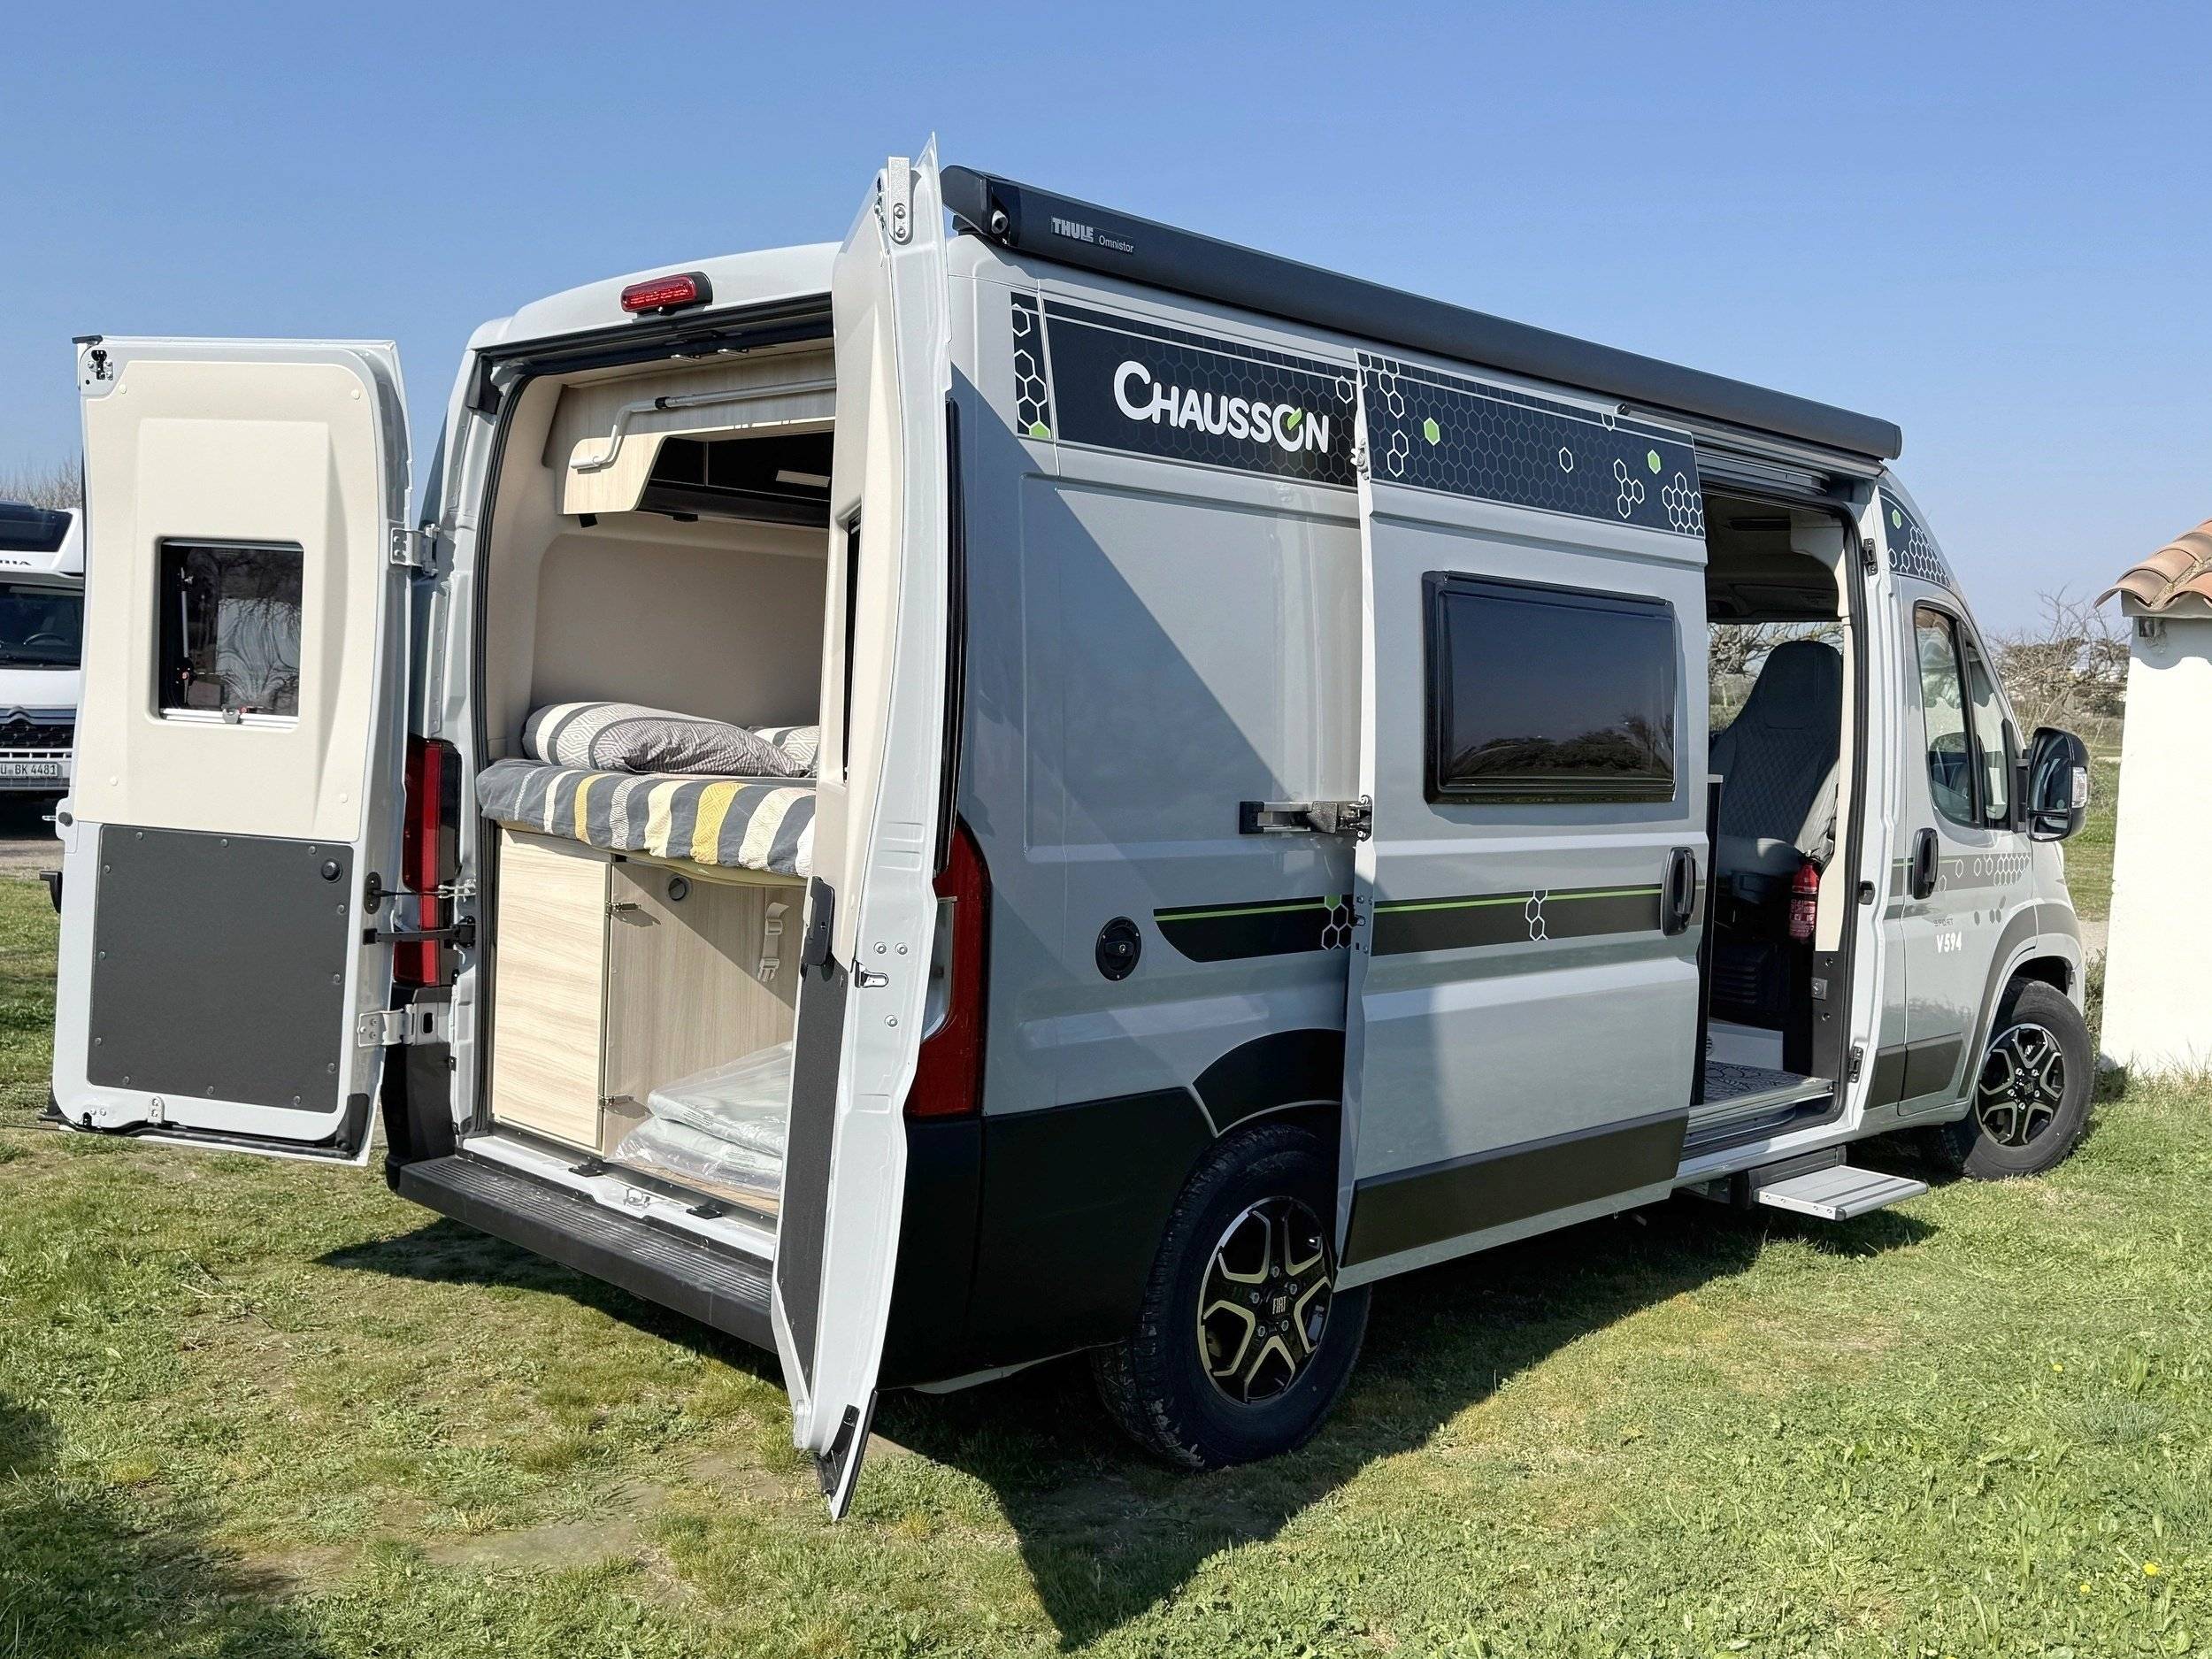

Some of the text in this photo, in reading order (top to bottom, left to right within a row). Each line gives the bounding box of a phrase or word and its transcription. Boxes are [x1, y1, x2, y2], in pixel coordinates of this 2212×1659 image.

[1052, 217, 1134, 253] THULE Omnistor
[1113, 360, 1329, 454] CHAUSSON
[15, 764, 27, 775] BK
[31, 764, 57, 775] 4481
[1936, 931, 1962, 953] V594
